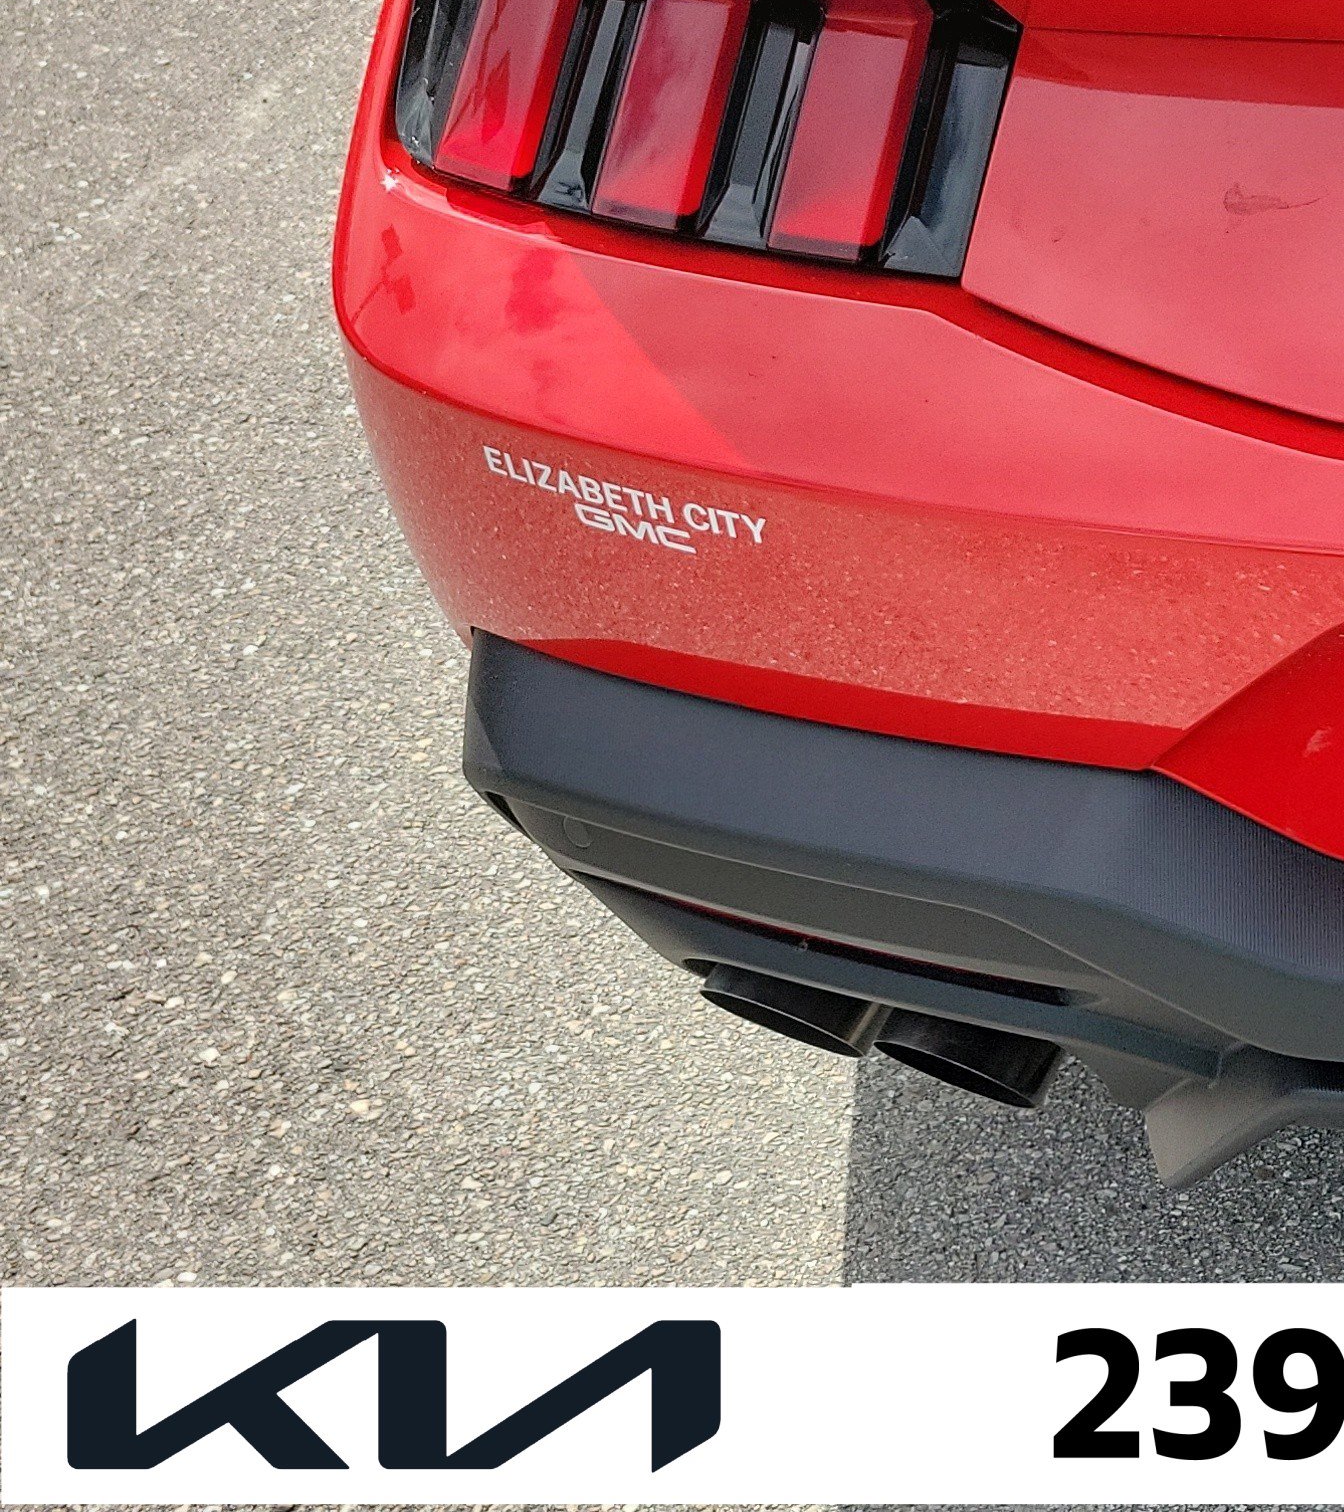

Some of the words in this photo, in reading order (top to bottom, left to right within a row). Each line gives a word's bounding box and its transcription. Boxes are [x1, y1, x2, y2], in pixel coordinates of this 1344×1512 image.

[483, 445, 675, 524] ELIZABETH
[683, 502, 767, 544] CITY
[574, 503, 697, 554] GMC
